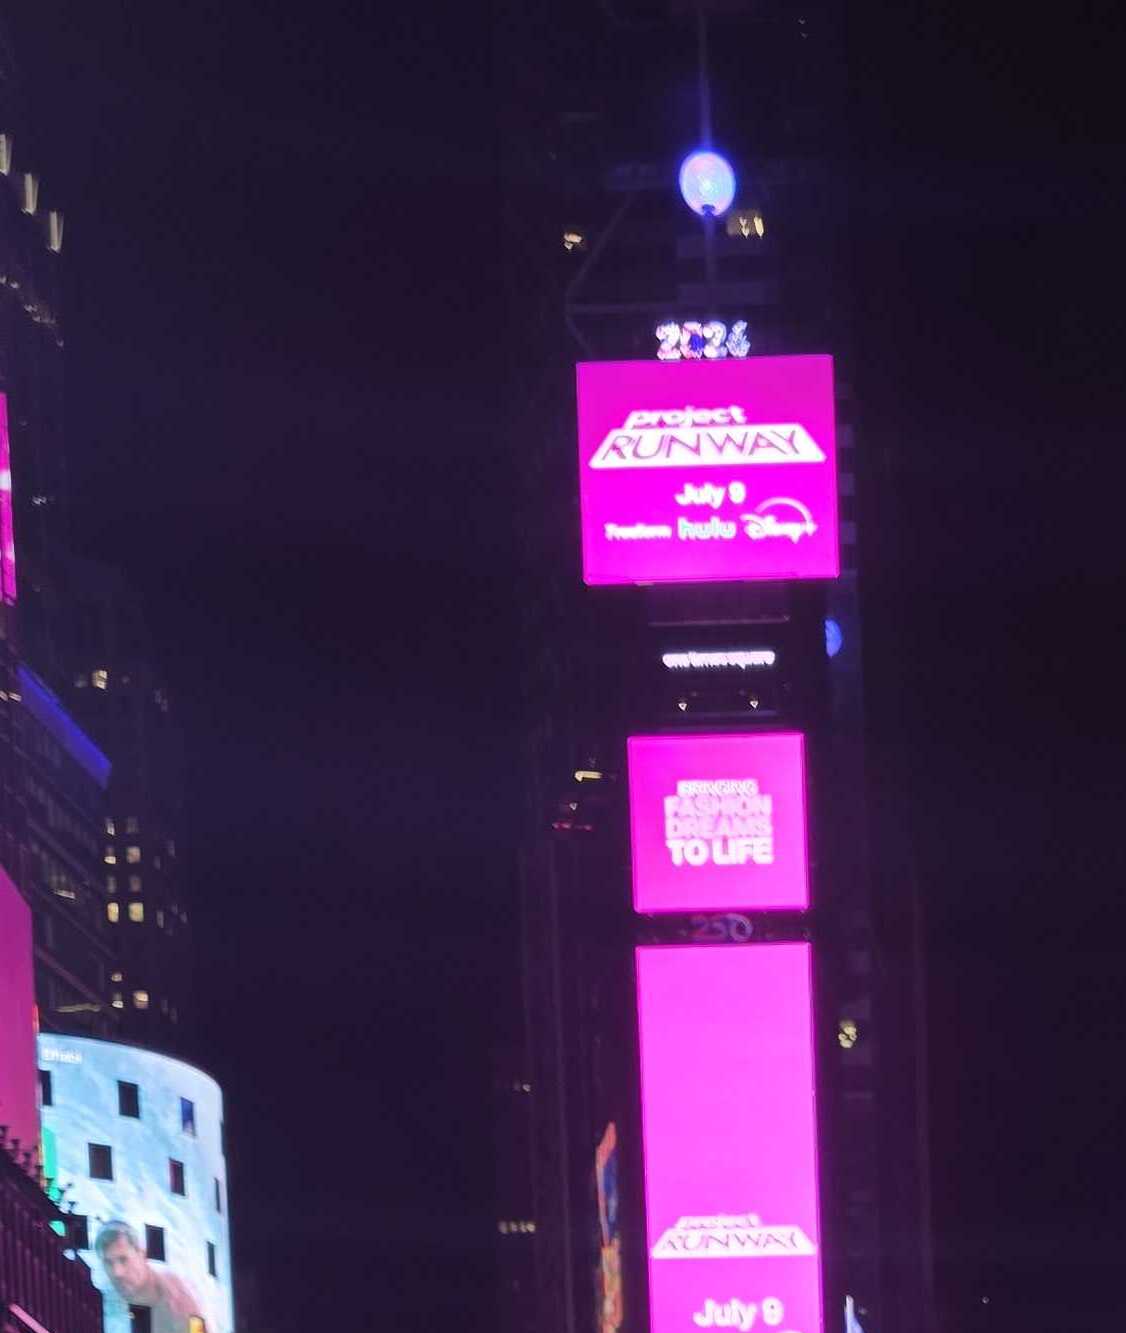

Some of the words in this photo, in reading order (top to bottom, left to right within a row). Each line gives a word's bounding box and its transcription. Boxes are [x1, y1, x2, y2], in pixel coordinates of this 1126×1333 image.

[601, 430, 801, 461] RUNWAY
[673, 482, 725, 509] July
[676, 516, 737, 541] hulu
[668, 838, 709, 866] TO
[712, 837, 774, 864] LIFE
[692, 1297, 757, 1333] July
[761, 1296, 785, 1326] 9
